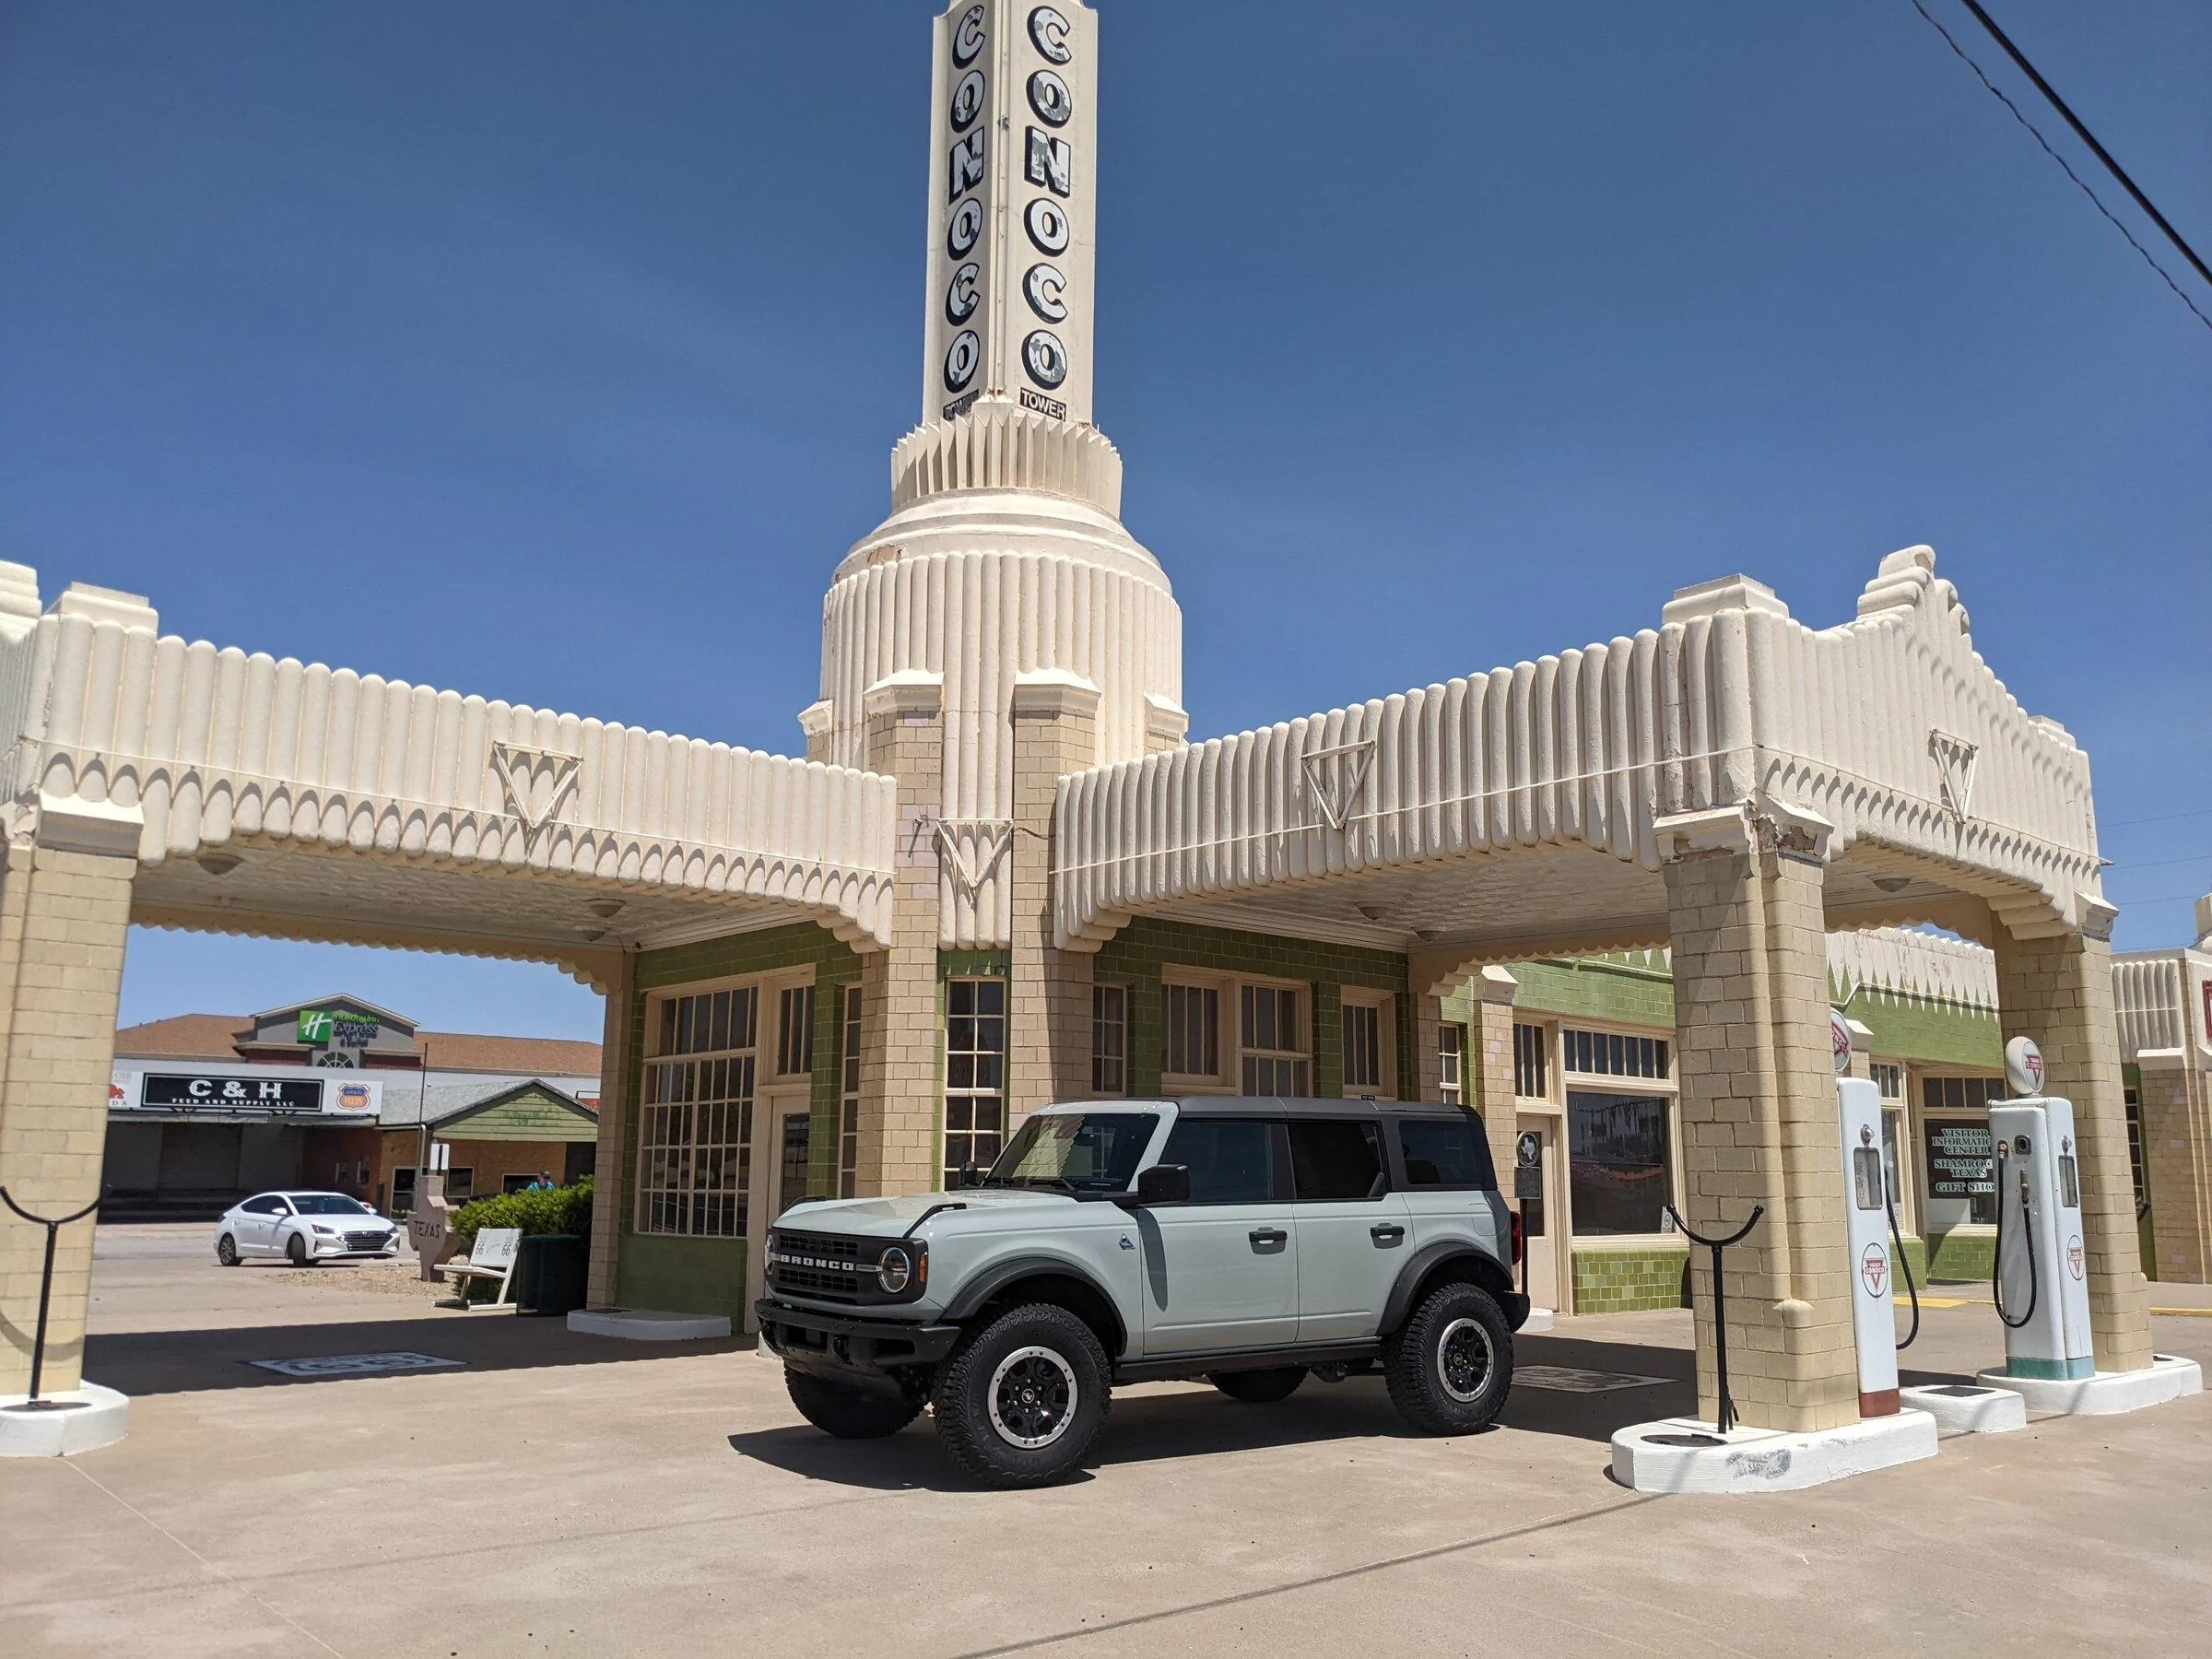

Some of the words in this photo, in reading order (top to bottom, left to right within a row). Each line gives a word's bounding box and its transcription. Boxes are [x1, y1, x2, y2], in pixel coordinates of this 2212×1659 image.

[944, 5, 985, 394] CONOCO
[1021, 6, 1072, 390] CONOCO
[1020, 388, 1066, 420] TOWER
[189, 1079, 213, 1097] C
[222, 1081, 247, 1098] &
[259, 1082, 282, 1099] H
[1941, 1128, 1990, 1138] VISITOR
[1932, 1136, 1991, 1147] INFORMATIO
[1944, 1146, 1990, 1155] CENTER
[1935, 1159, 1993, 1169] SHAMROC
[1950, 1168, 1987, 1178] TEXAS
[1936, 1182, 1966, 1192] GIFT
[1967, 1182, 1994, 1192] SHO
[414, 1220, 441, 1239] TEXAS
[501, 1243, 512, 1256] 66
[781, 1254, 854, 1271] BRONCO
